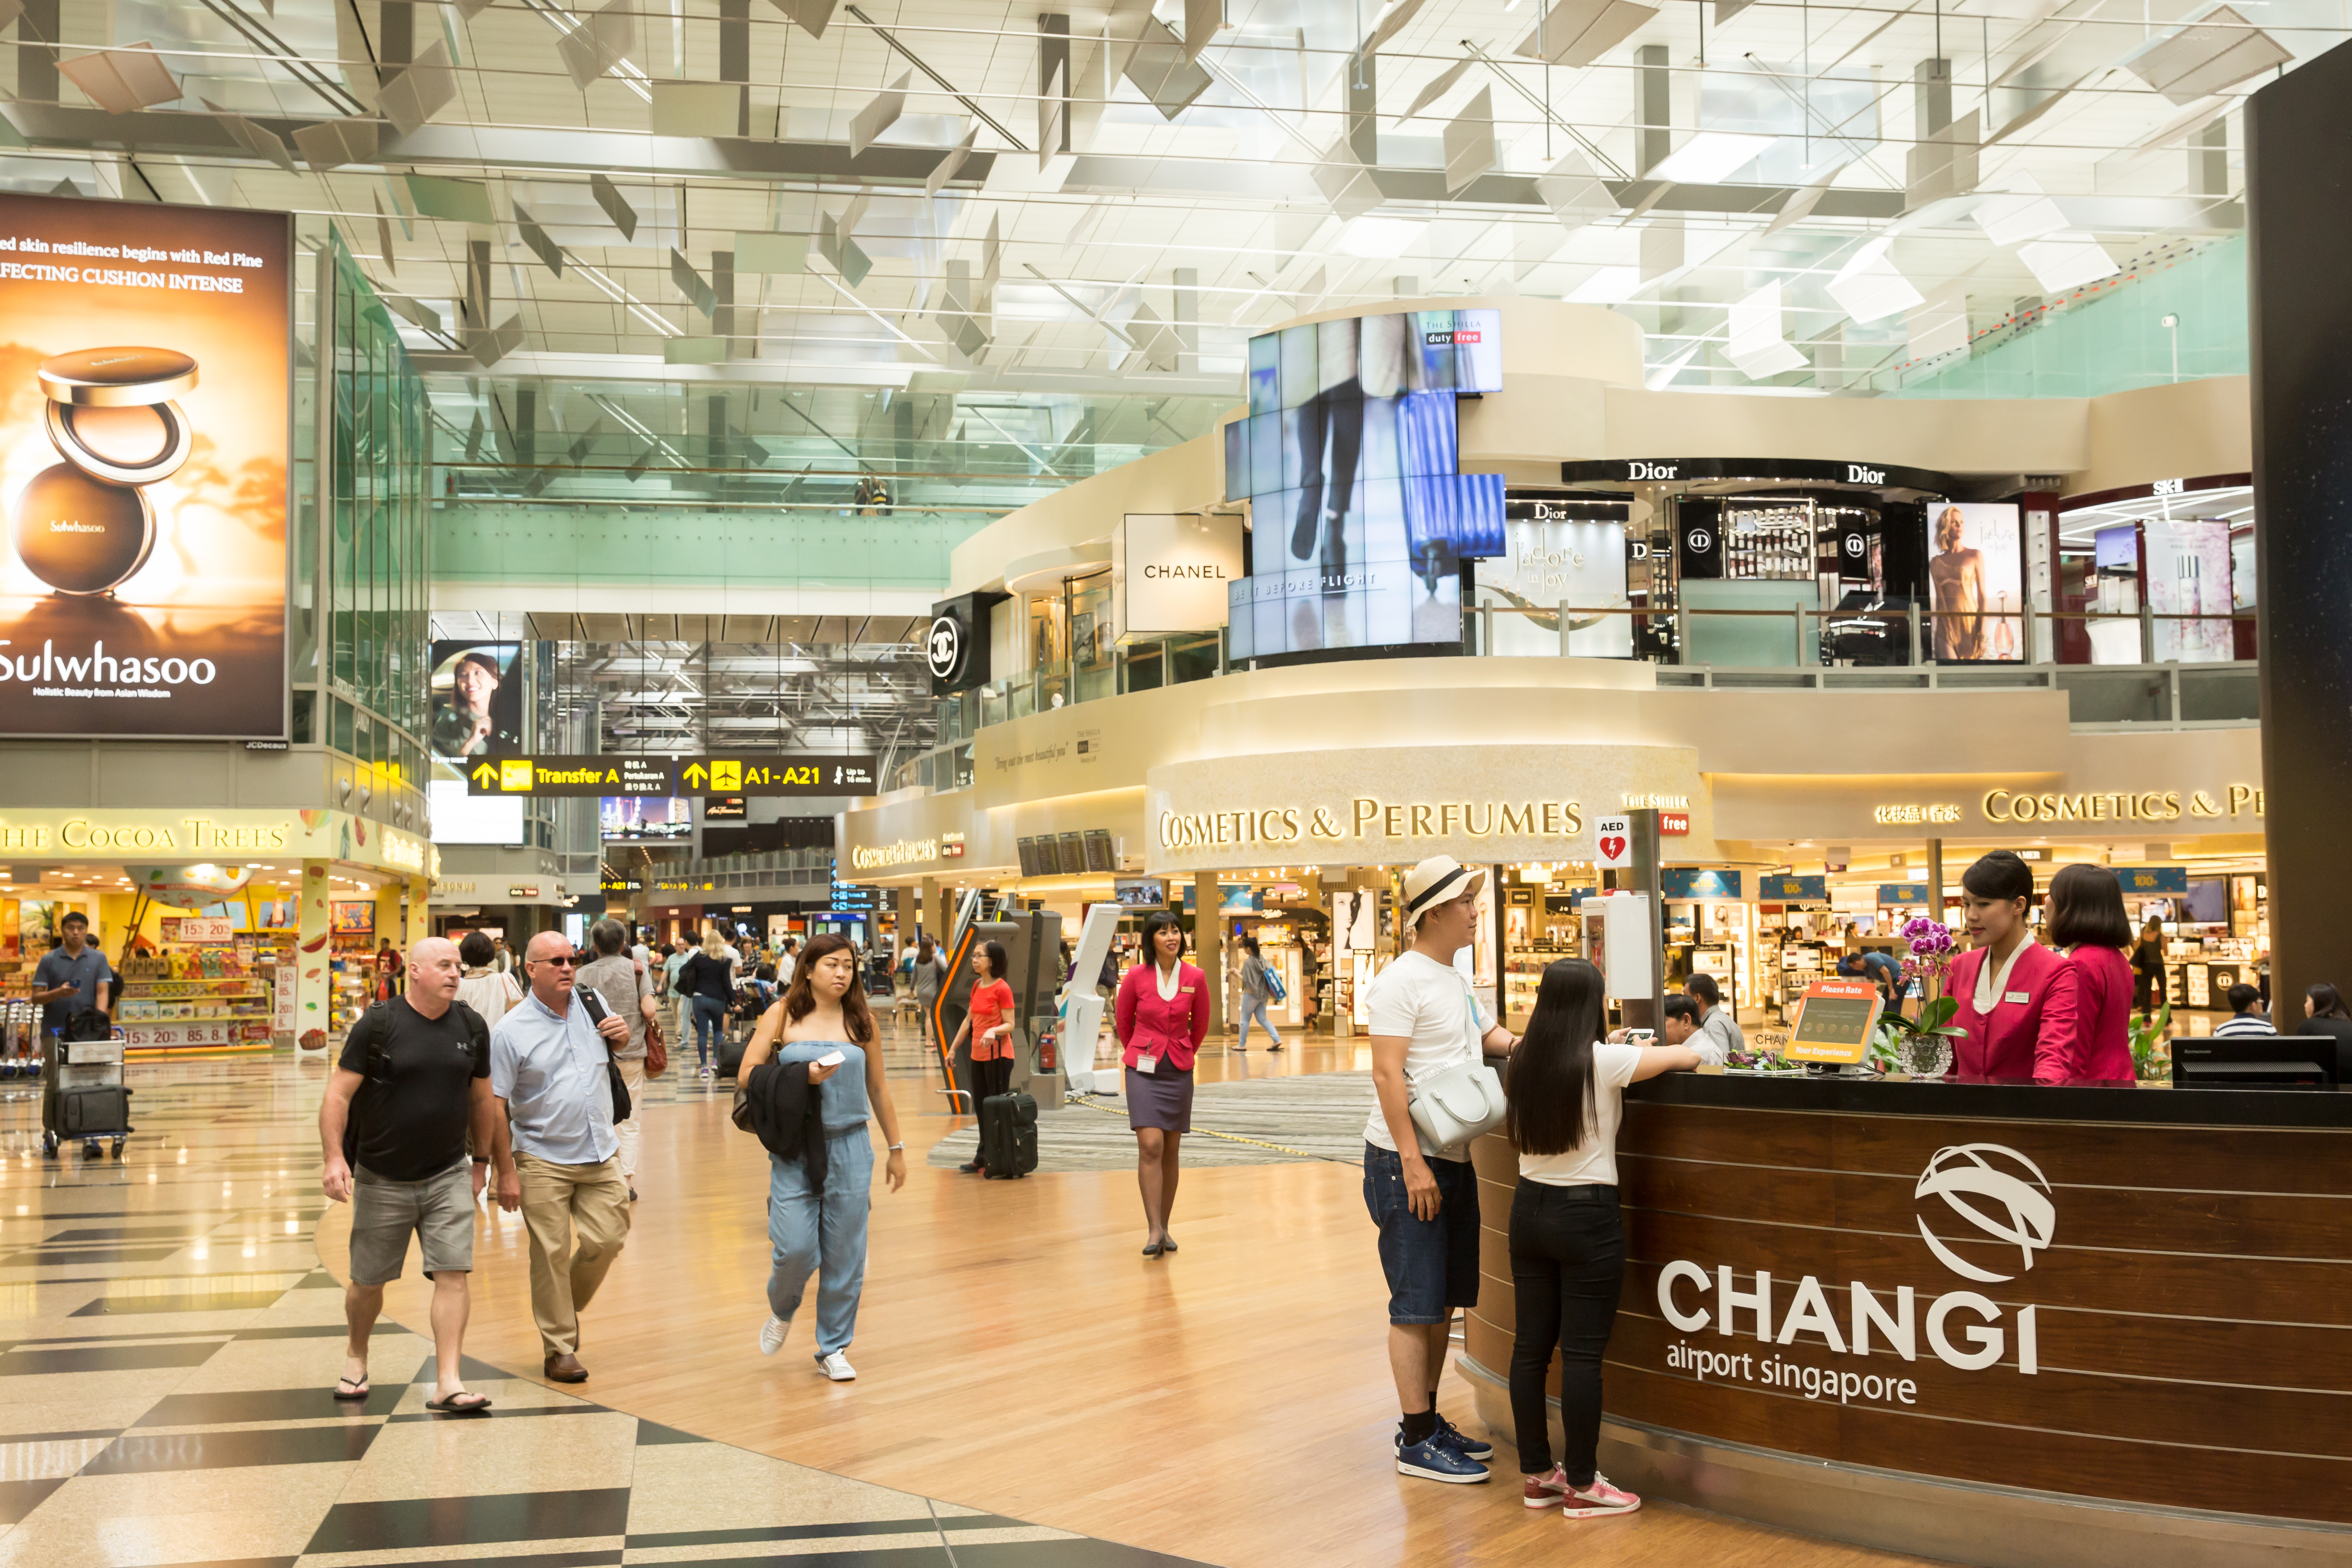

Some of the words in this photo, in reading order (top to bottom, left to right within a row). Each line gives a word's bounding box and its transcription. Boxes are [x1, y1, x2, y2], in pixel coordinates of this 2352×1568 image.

[19, 237, 49, 253] skin
[52, 241, 120, 258] resilience
[122, 245, 167, 262] begins
[170, 249, 200, 263] with
[203, 251, 230, 265] Red
[232, 253, 263, 268] Pine
[82, 268, 165, 288] CUSHION
[168, 273, 243, 293] INTENSE
[1428, 334, 1451, 344] duty
[1457, 332, 1478, 341] free
[1628, 462, 1678, 480] Dior
[1847, 465, 1885, 484] Dior
[1534, 504, 1567, 519] Dior
[50, 519, 105, 533] Sulwhasoo
[1144, 565, 1226, 578] CHANEL
[1321, 573, 1375, 587] FLIGHT
[0, 639, 216, 684] Sulwhasoo
[94, 688, 114, 697] from
[115, 688, 138, 697] Asian
[138, 688, 171, 698] Wisdom
[536, 767, 602, 784] Transfer
[605, 768, 620, 783] A
[846, 768, 857, 777] Up
[1625, 795, 1647, 807] THE
[1652, 794, 1690, 807] SHILLA
[1984, 789, 2180, 820] COSMETICS
[2191, 791, 2222, 817] &
[1160, 809, 1298, 847] COSMETICS
[1310, 808, 1342, 837] &
[1353, 799, 1582, 837] PERFUMES
[1601, 822, 1624, 831] AED
[1663, 815, 1687, 831] free
[62, 820, 175, 848] COCOA
[184, 820, 283, 848] TREES
[1821, 985, 1844, 994] Please
[1845, 986, 1862, 994] Rate
[1795, 1046, 1812, 1054] Your
[1812, 1047, 1853, 1057] Experience
[1657, 1259, 2038, 1375] CHANGI
[1667, 1339, 1753, 1381] airport
[1761, 1353, 1917, 1404] singapore
